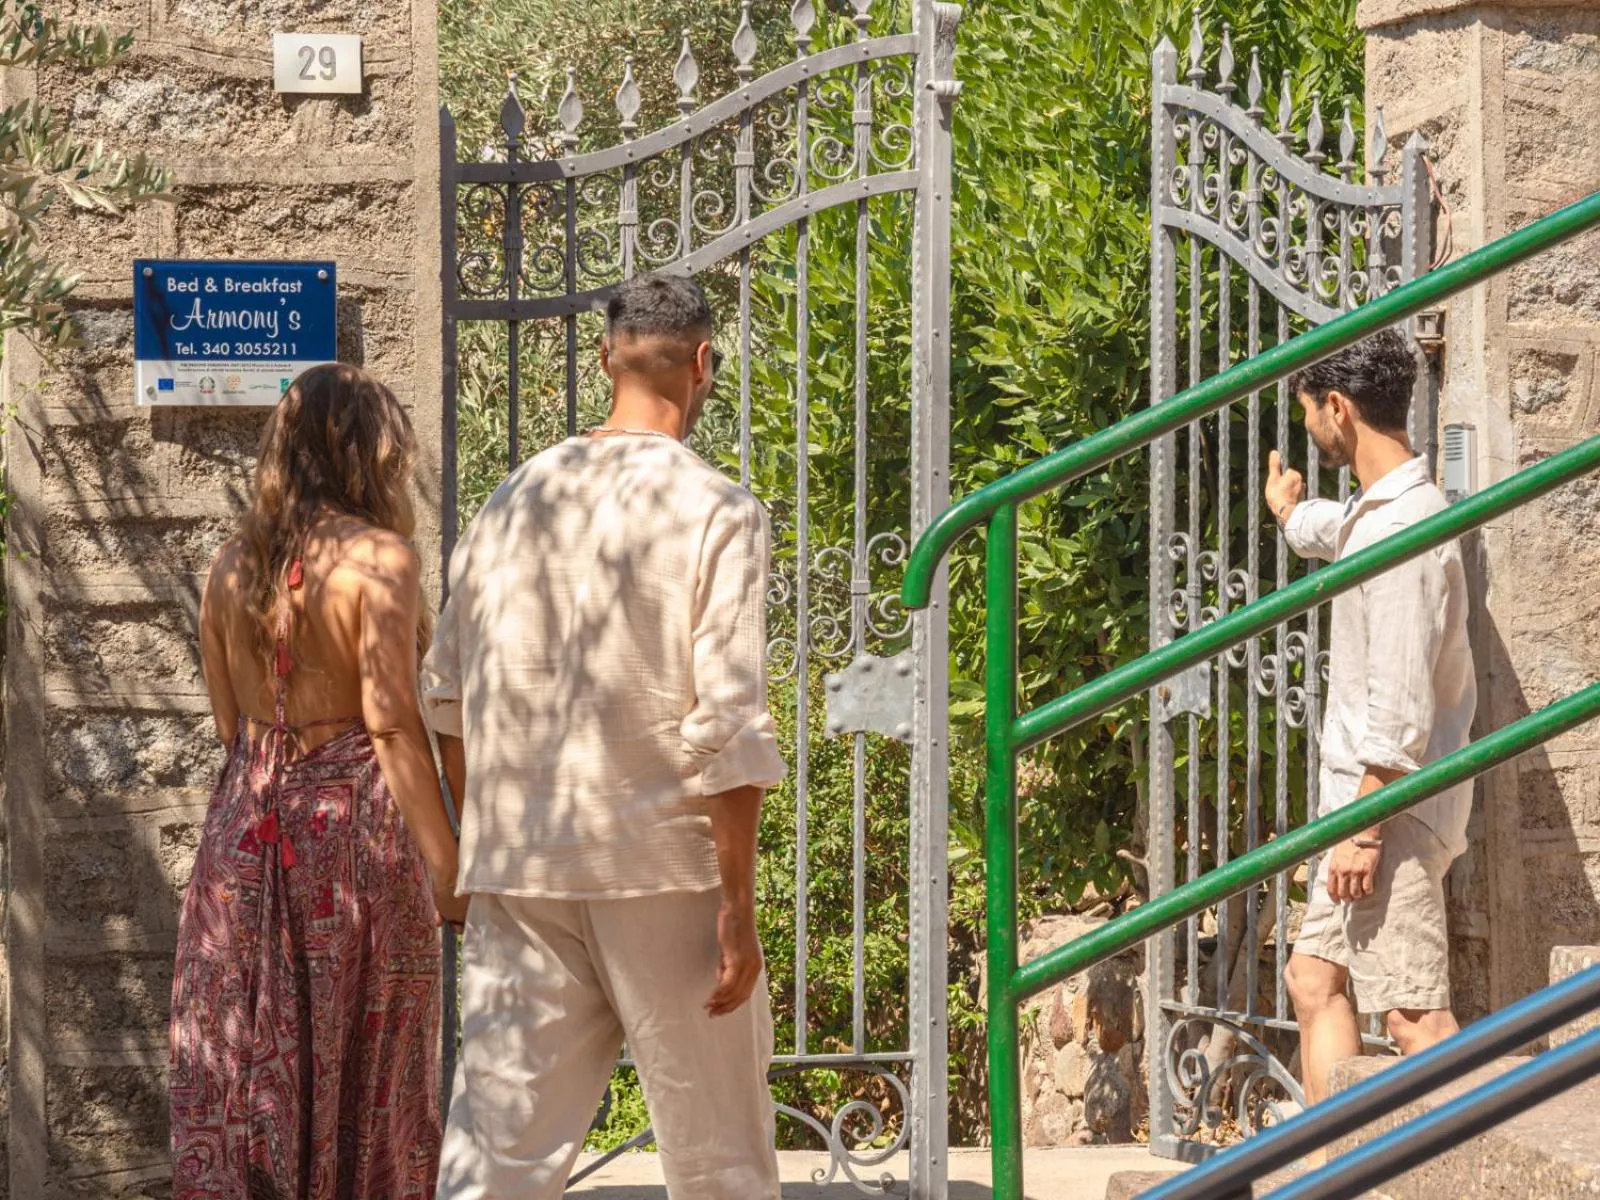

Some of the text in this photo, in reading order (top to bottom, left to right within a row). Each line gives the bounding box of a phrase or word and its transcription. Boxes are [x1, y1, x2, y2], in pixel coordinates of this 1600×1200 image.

[298, 45, 337, 80] 29
[167, 277, 303, 293] Bed & Breakfast
[170, 297, 301, 338] Armony's
[175, 342, 297, 356] Tel. 340 3055211
